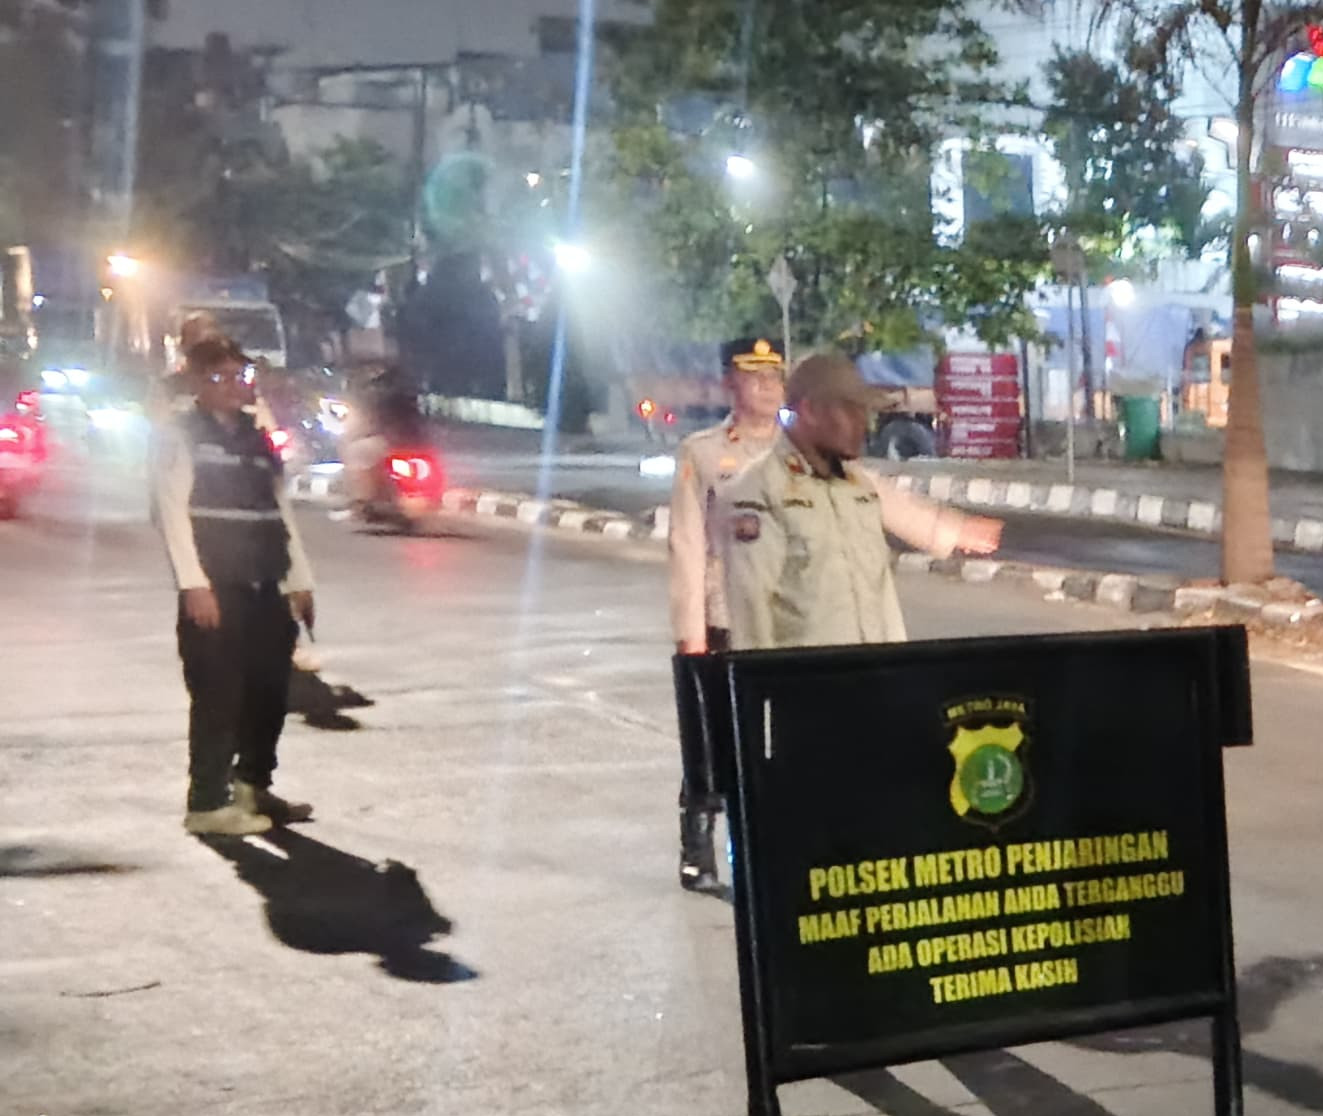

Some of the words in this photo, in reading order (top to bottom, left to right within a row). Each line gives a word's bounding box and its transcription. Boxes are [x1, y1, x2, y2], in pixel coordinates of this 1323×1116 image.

[809, 861, 909, 900] POLSEK
[913, 846, 1001, 887] METRO
[1006, 830, 1168, 876] PENJARINGAN
[798, 909, 861, 944] MAAF
[865, 890, 999, 934] PERJALANAN
[1004, 883, 1060, 915] ANDA
[1063, 871, 1184, 908] TERGANGGU
[868, 941, 913, 974] ADA
[916, 929, 1007, 967] OPERASI
[1011, 914, 1131, 953] KEPOLISIAN
[929, 966, 1013, 1003] TERIMA
[1014, 957, 1078, 991] KASIH
